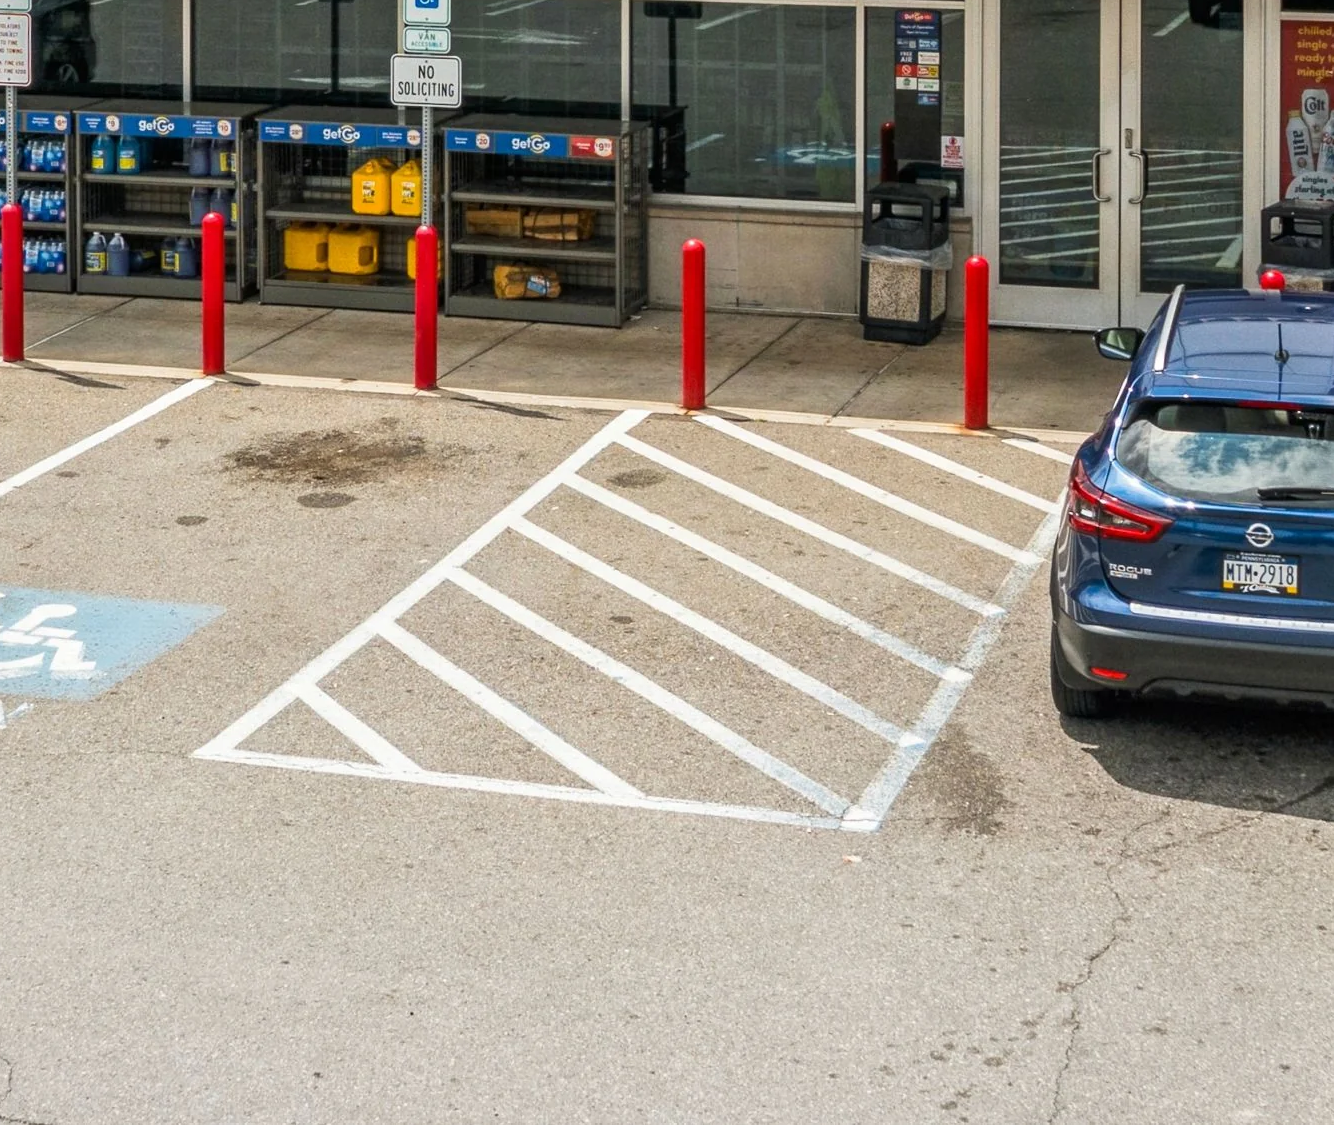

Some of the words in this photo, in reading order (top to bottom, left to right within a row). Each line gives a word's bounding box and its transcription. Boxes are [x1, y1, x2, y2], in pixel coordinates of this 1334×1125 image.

[418, 33, 436, 41] VAN
[1298, 27, 1334, 37] chilled,
[1297, 40, 1328, 51] single
[1294, 54, 1327, 65] ready
[418, 65, 435, 79] NO
[398, 81, 454, 97] SOLICITING
[1304, 96, 1326, 115] Colt
[138, 119, 175, 132] getGo
[323, 127, 360, 140] getGo
[511, 137, 550, 150] getGo
[1293, 130, 1309, 157] Lite
[1301, 176, 1328, 185] singles
[1109, 563, 1152, 576] ROGUE
